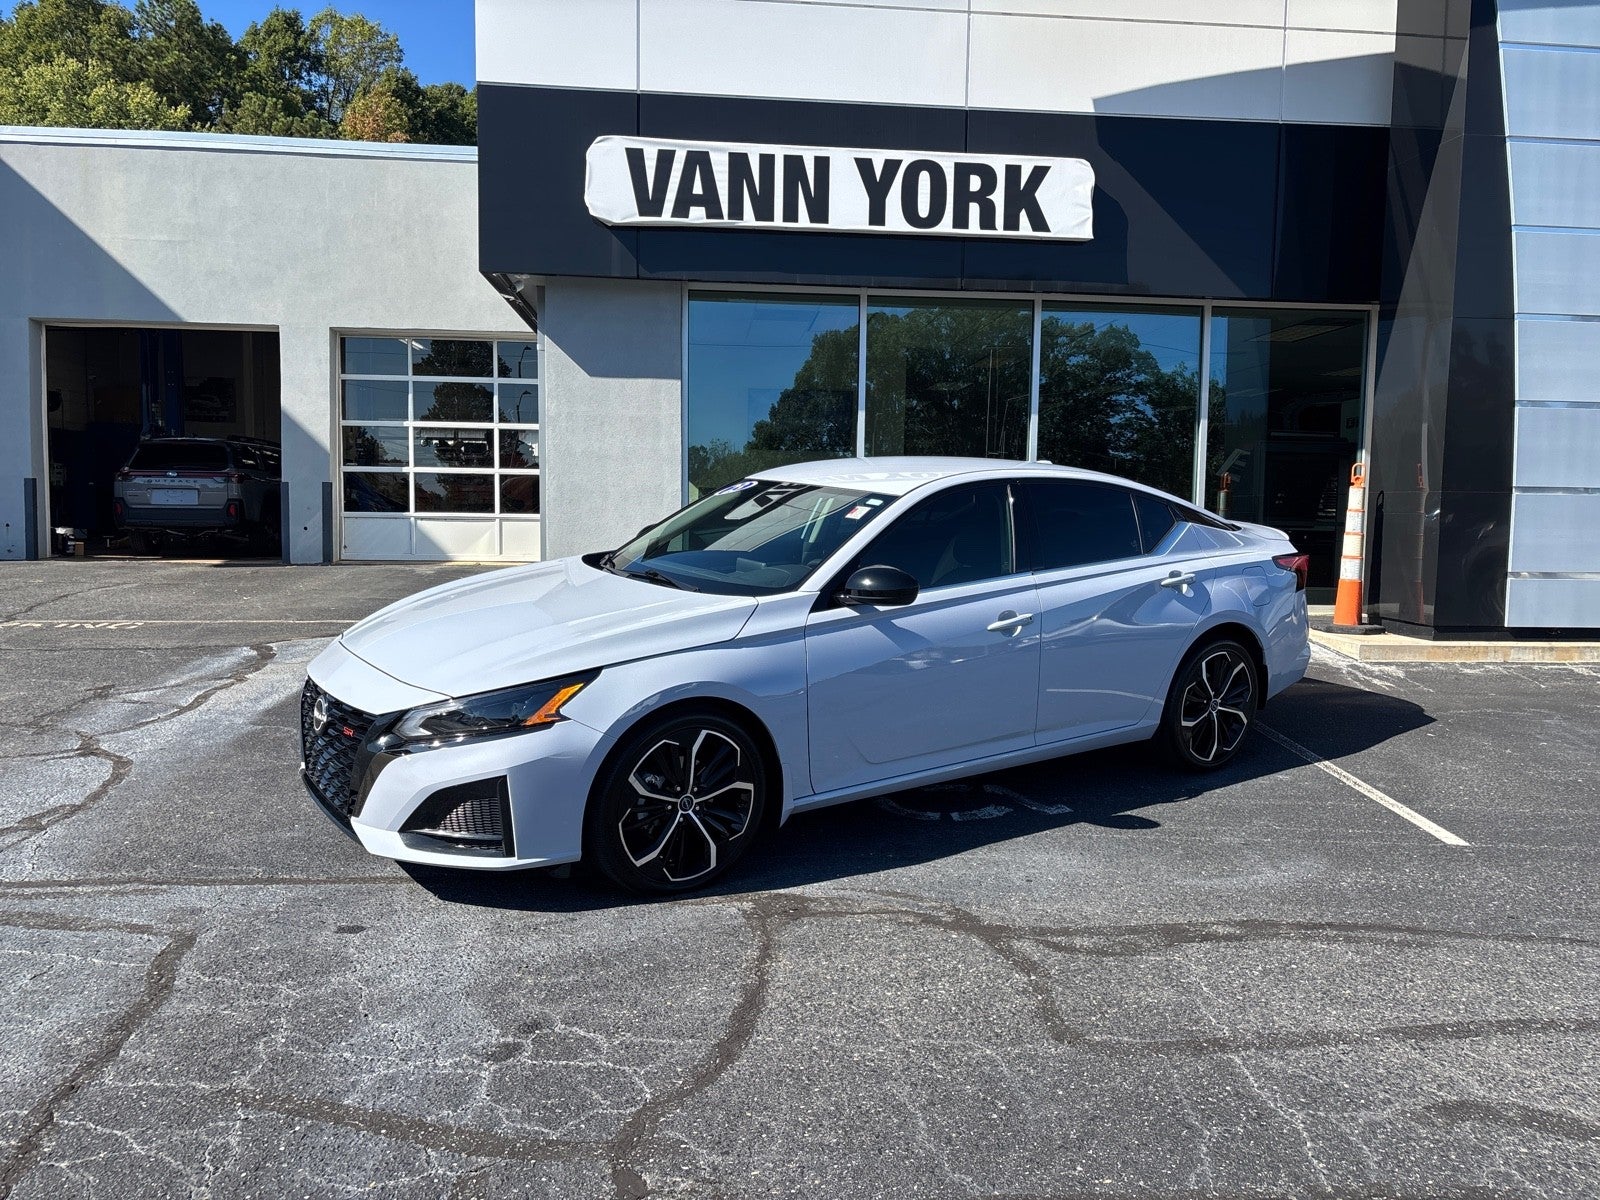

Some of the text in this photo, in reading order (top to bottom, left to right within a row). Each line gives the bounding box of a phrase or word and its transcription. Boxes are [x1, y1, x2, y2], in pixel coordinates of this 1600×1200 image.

[625, 147, 1052, 233] VANN YORK
[343, 726, 354, 737] SR
